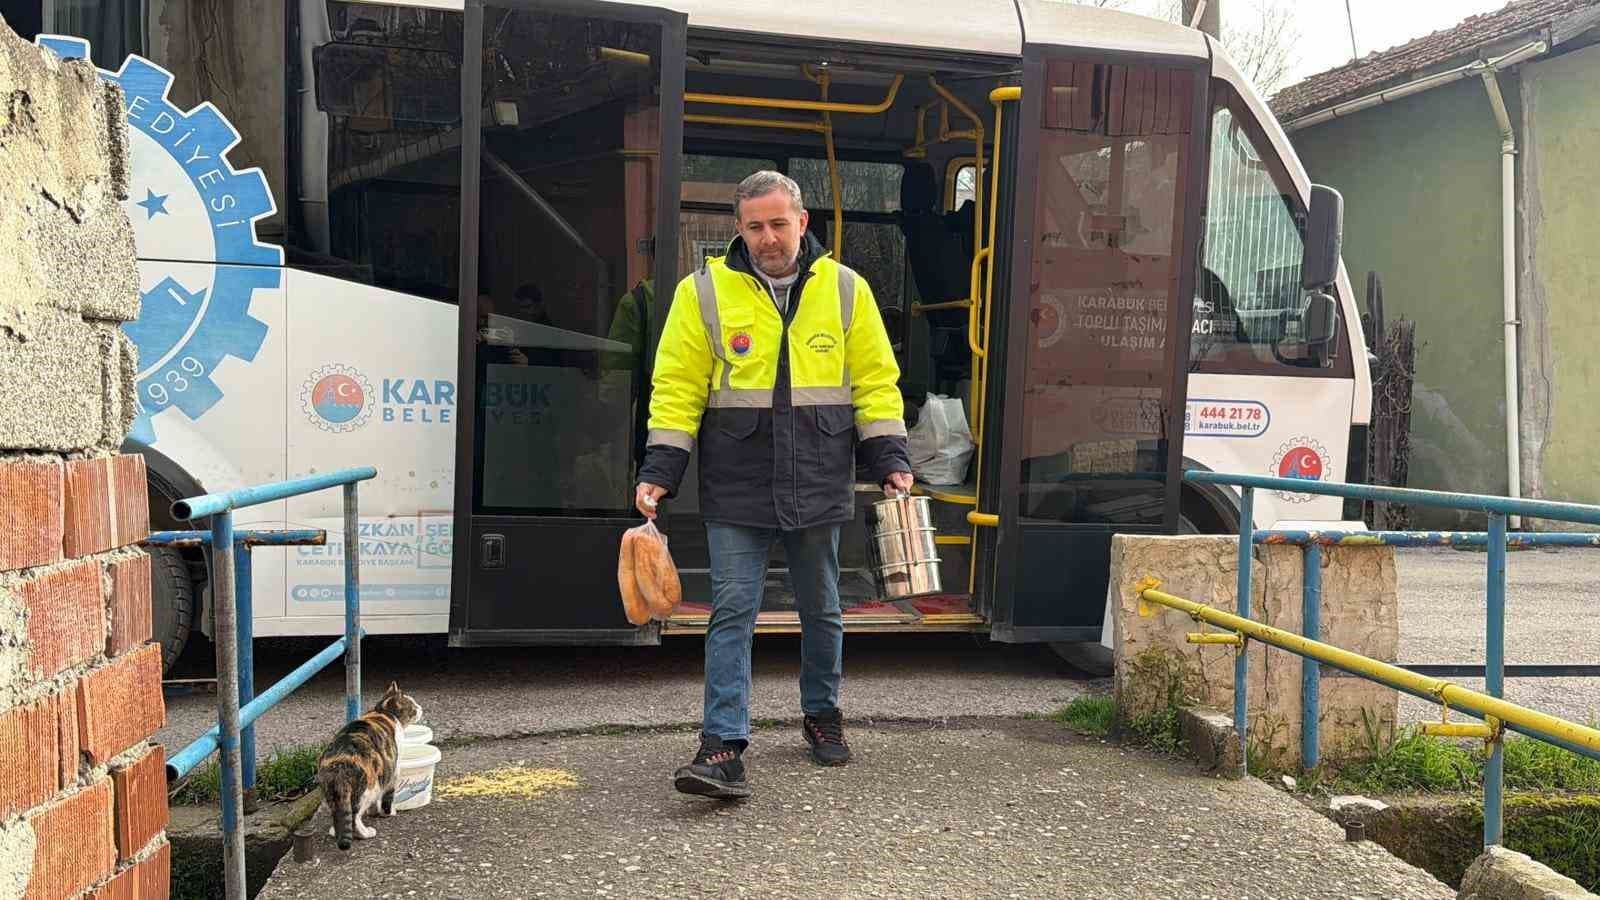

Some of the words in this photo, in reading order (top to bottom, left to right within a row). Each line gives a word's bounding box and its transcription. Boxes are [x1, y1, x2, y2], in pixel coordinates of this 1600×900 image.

[127, 96, 246, 228] EDİYESİ
[1200, 407, 1226, 420] 444
[1229, 408, 1244, 420] 21
[1246, 408, 1262, 421] 78
[1199, 420, 1261, 432] karabuk.bel.tr
[358, 523, 414, 537] ZKAN
